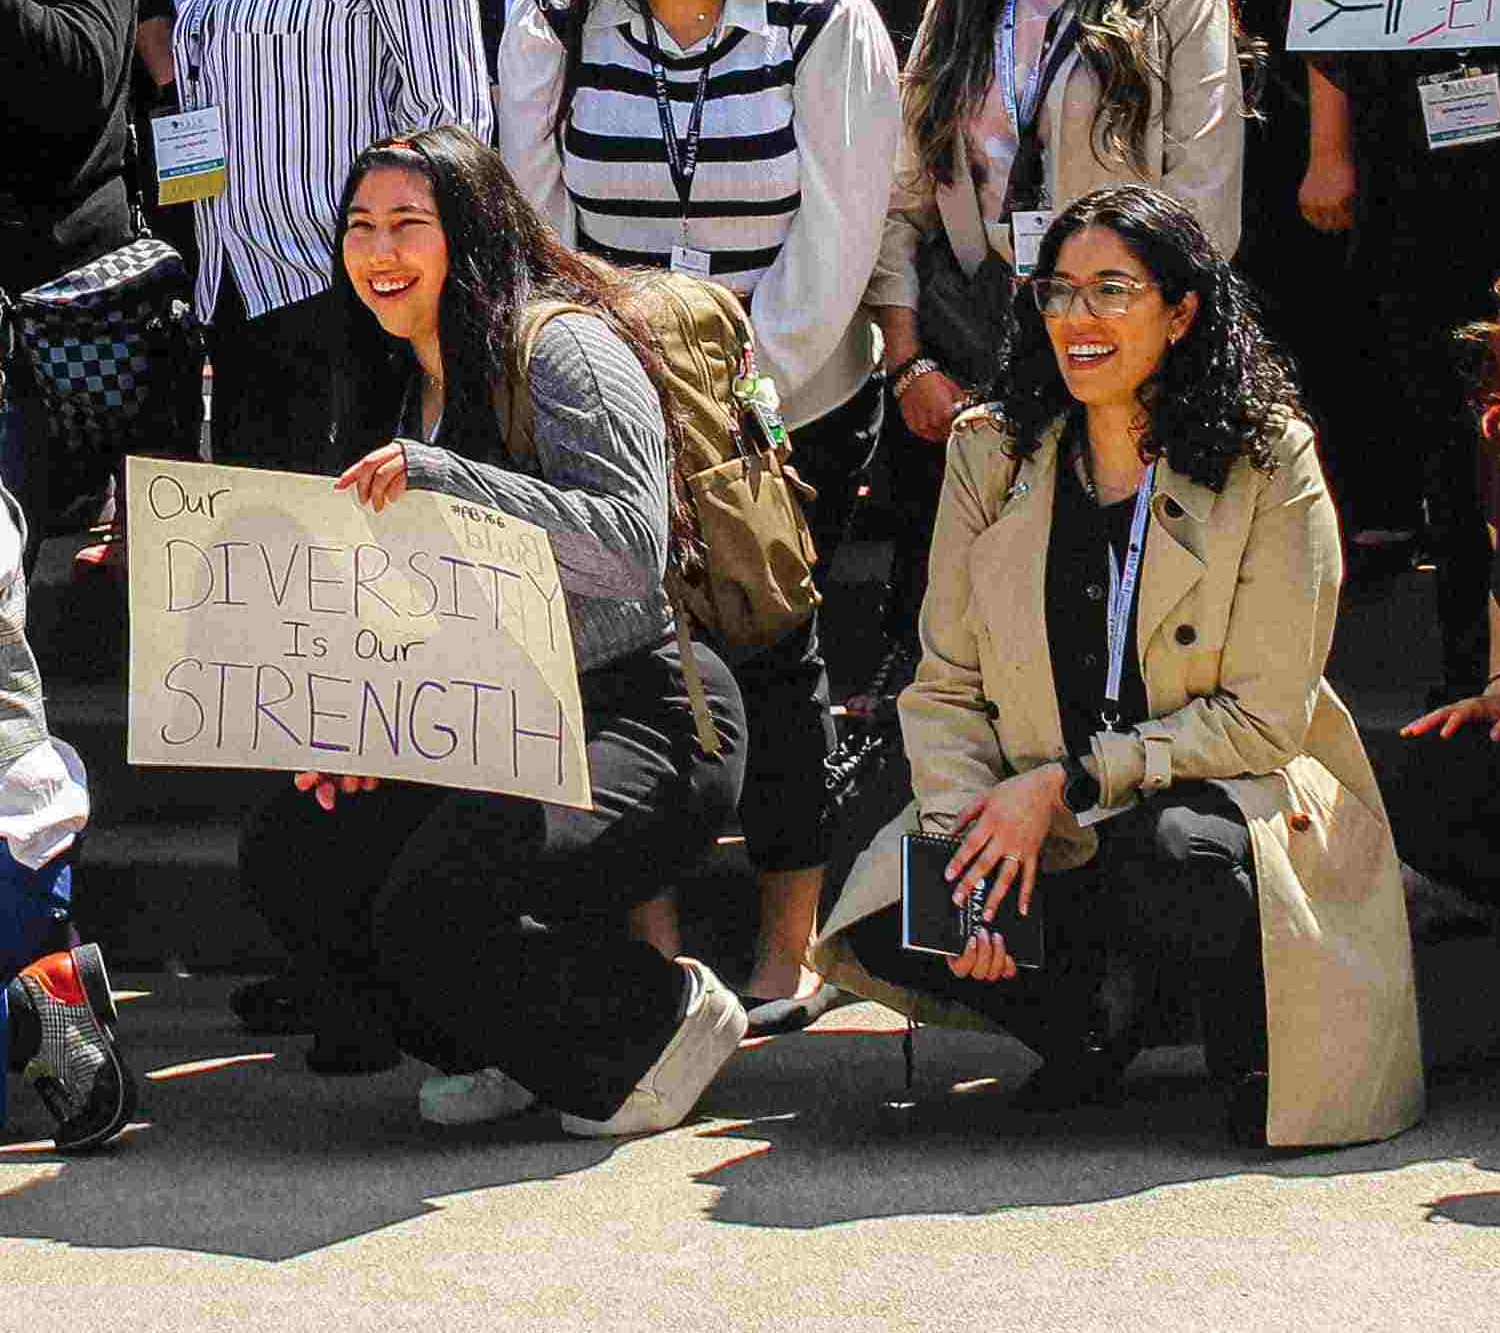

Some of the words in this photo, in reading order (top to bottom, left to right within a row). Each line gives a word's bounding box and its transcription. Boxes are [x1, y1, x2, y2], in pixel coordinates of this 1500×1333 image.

[148, 475, 231, 520] Our
[166, 538, 562, 653] DIVERSITY
[282, 621, 329, 658] Is
[354, 628, 425, 664] Our
[160, 657, 565, 787] STRENGTH
